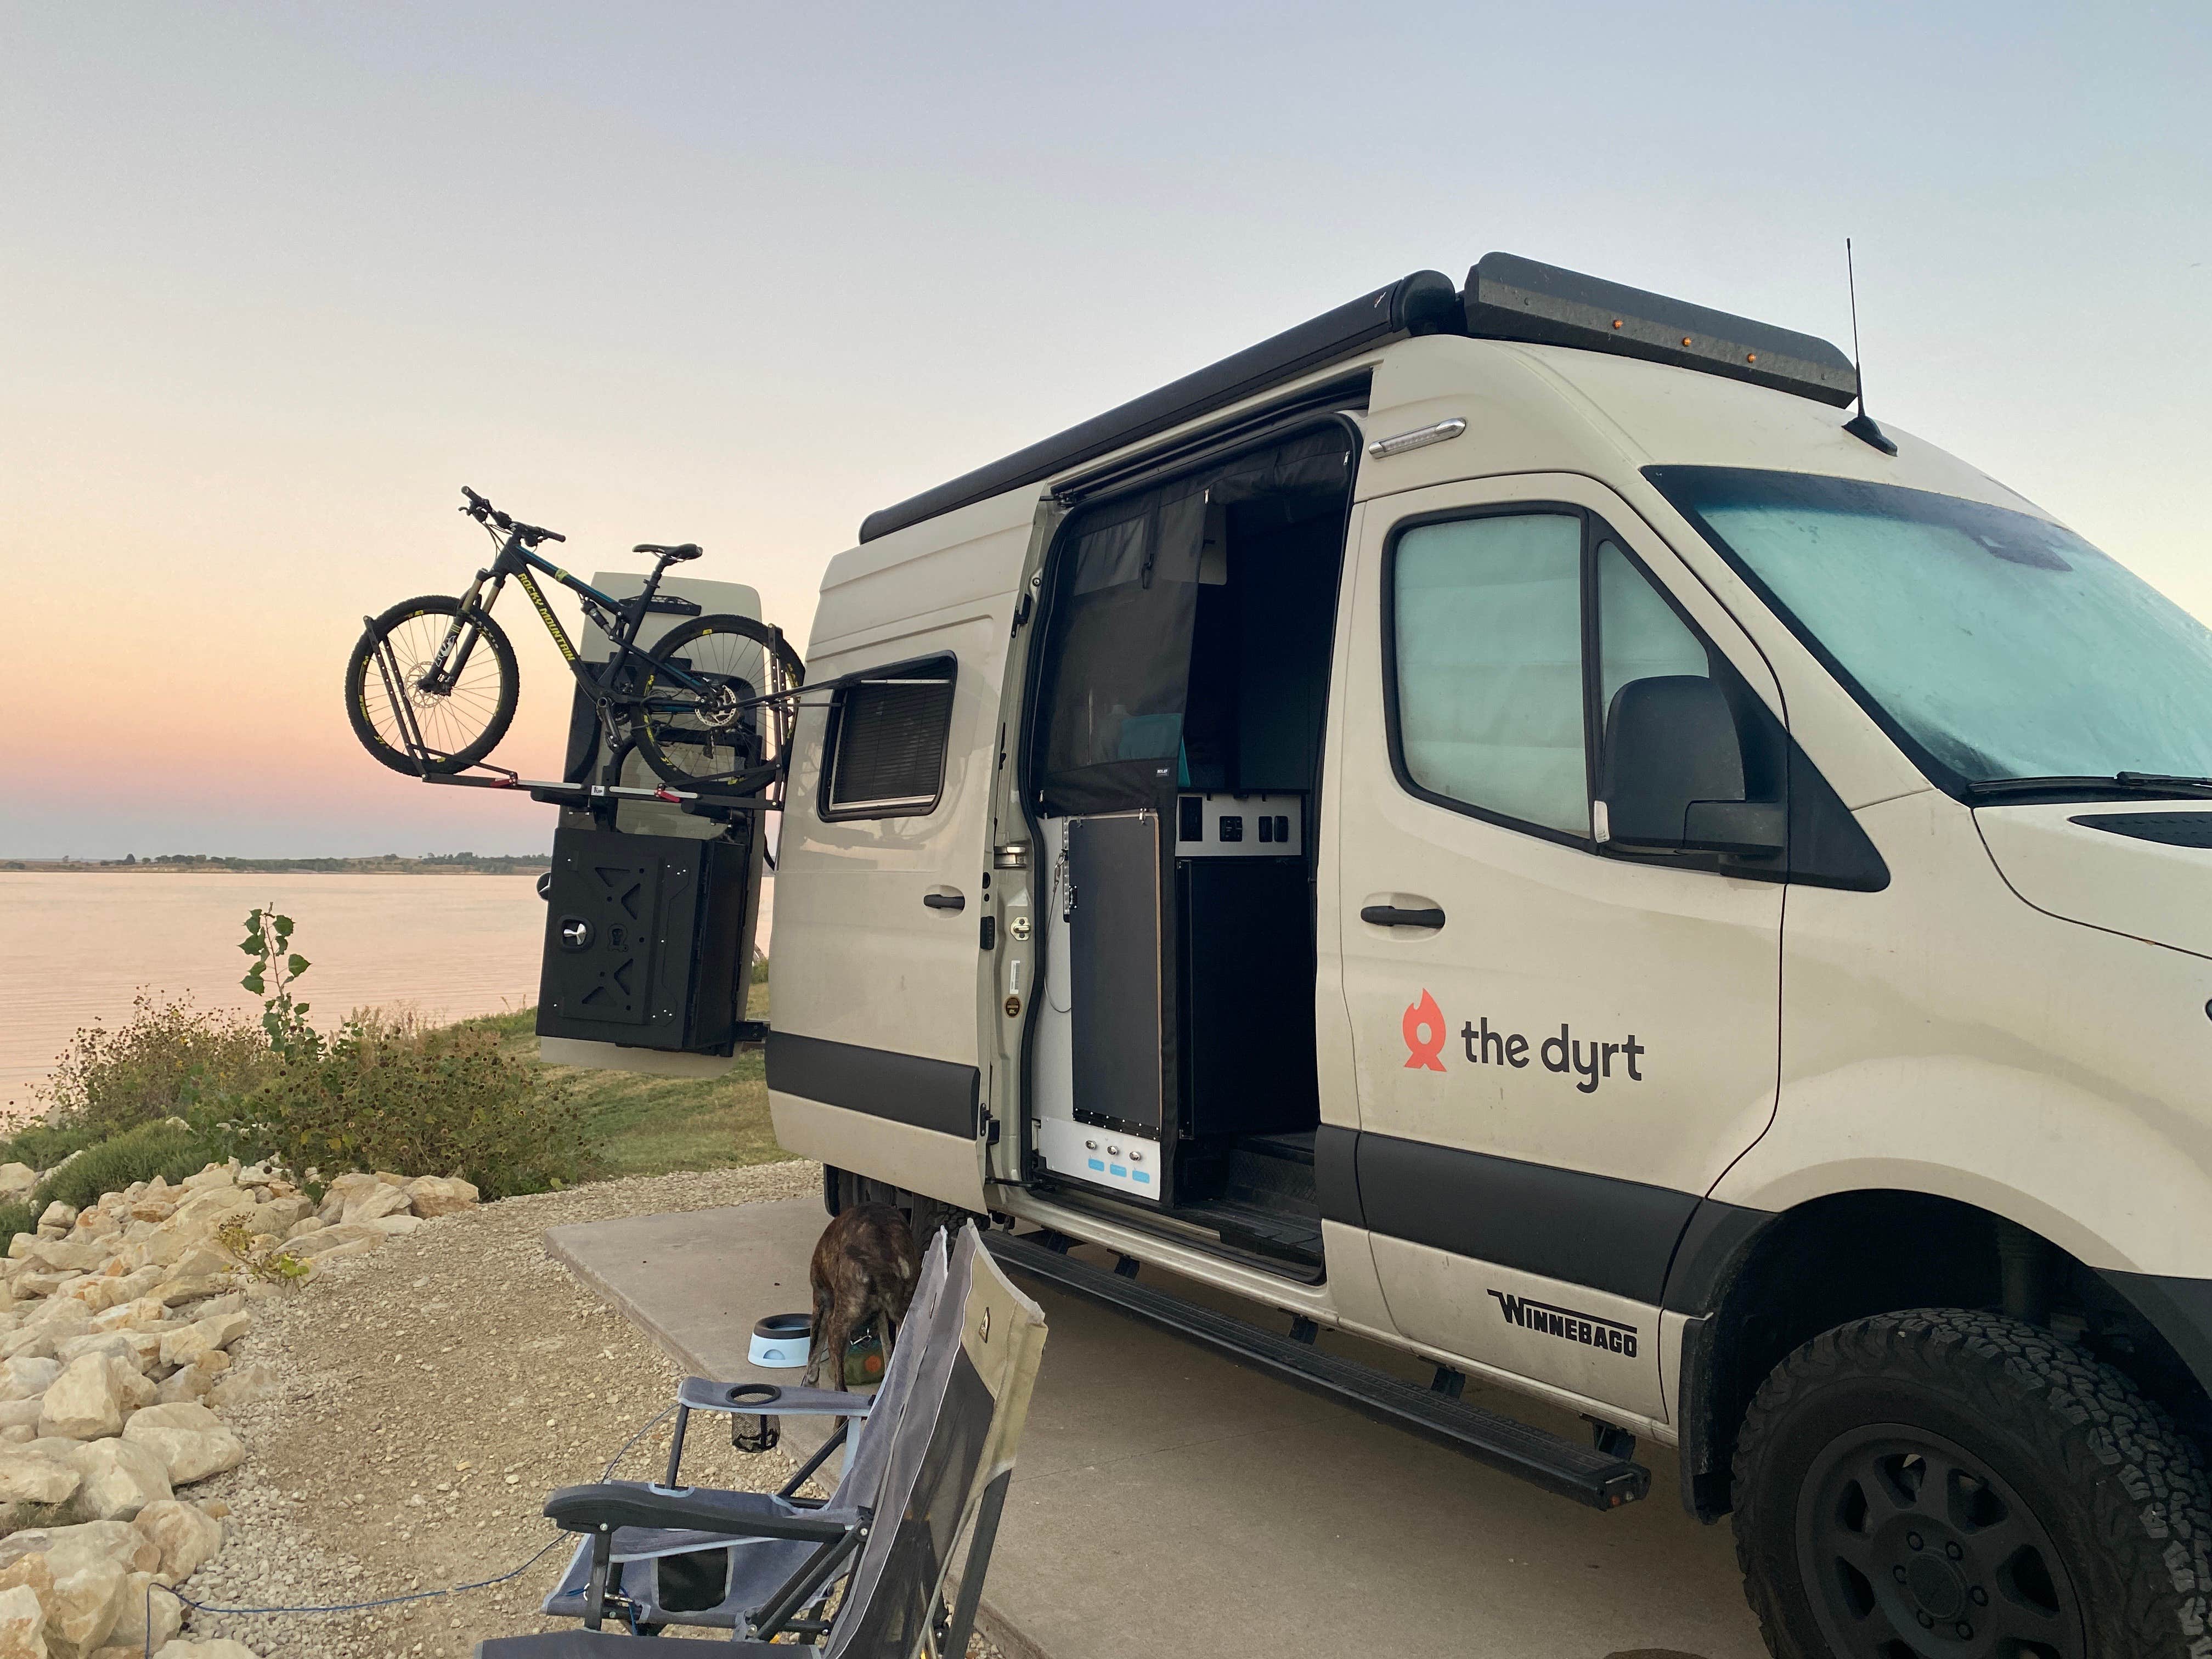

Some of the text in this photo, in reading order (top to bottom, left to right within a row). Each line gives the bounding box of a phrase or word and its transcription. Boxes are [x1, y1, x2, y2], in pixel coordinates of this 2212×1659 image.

[518, 573, 575, 661] ROCKY MOUNTAIN
[1461, 1017, 1644, 1093] the dyrt
[1487, 1289, 1637, 1358] WINNEBAGO
